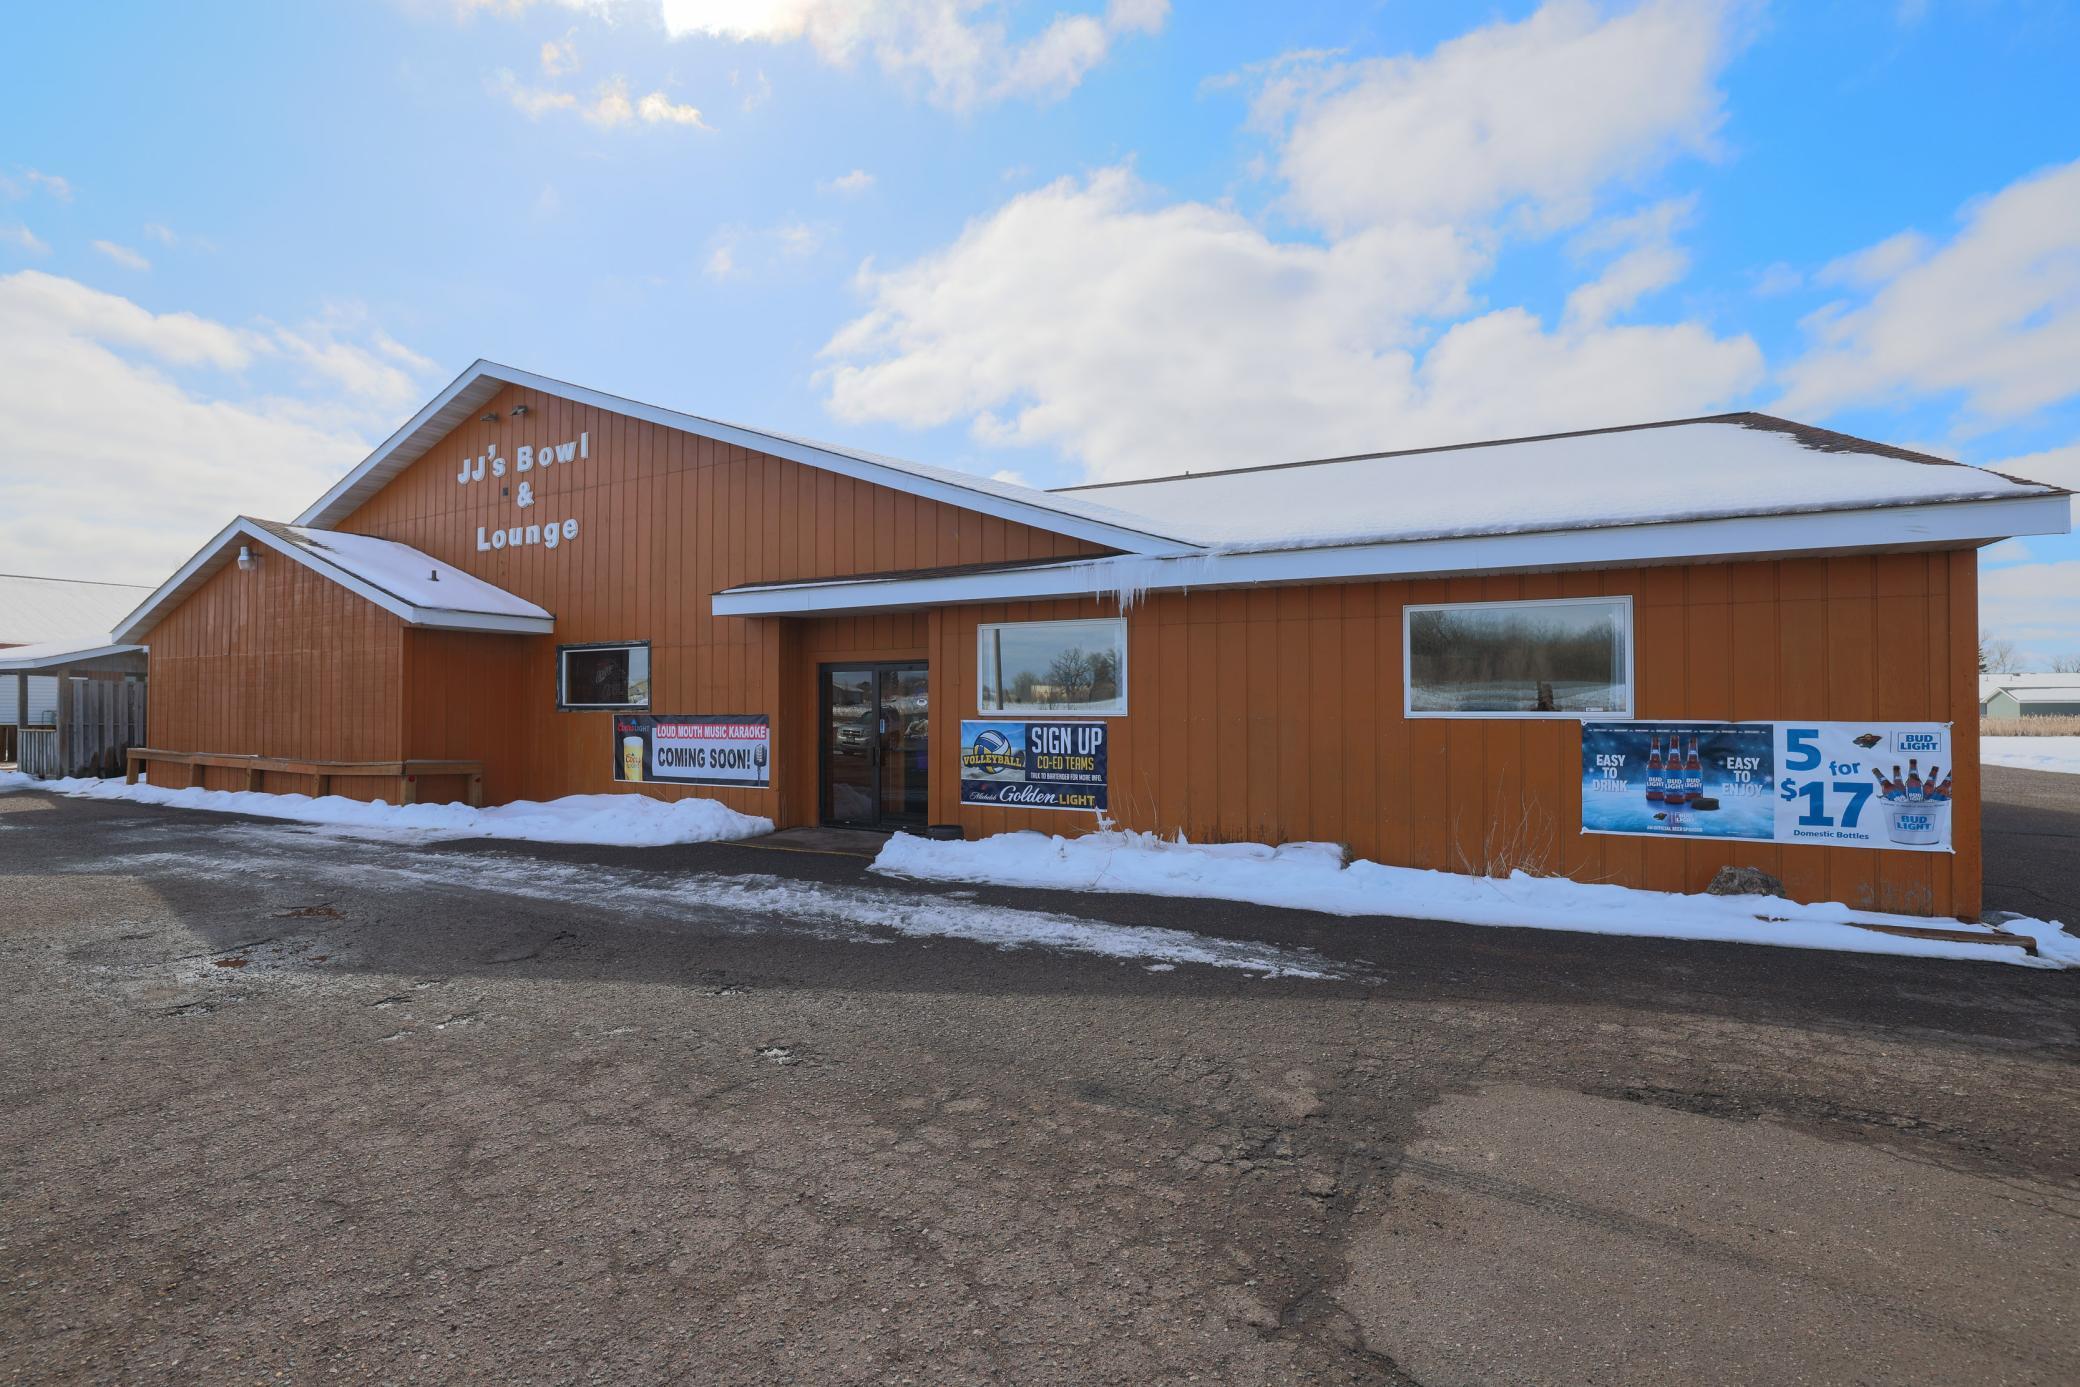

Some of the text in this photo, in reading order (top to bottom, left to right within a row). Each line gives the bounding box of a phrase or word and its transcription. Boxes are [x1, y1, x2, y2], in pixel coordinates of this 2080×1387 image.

[457, 431, 589, 485] JJ's Bowl
[516, 481, 535, 508] &
[476, 518, 579, 552] Lounge
[657, 725, 766, 739] LOUD MOUTH MUSIC KARAOKE
[1905, 734, 1934, 743] BUD
[1031, 727, 1103, 755] SIGN UP
[1900, 742, 1939, 751] LIGHT
[658, 747, 706, 769] COMING
[710, 748, 751, 770] SOON!
[1785, 728, 1861, 776] 5 for
[963, 754, 1022, 767] VOLLEYBALL
[1037, 755, 1094, 771] CO-ED TEAMS
[1596, 754, 1626, 767] EASY
[1726, 757, 1760, 770] EASY
[1601, 767, 1618, 779] TO
[1733, 770, 1751, 783] TO
[1592, 779, 1628, 793] DRINK
[1722, 783, 1763, 798] ENJOY
[999, 784, 1058, 804] Golden
[1059, 794, 1095, 807] LIGHT
[1780, 777, 1874, 828] $17
[1896, 822, 1933, 831] LIGHT
[1901, 815, 1928, 824] BUD
[1793, 829, 1870, 840] Domestic Bottles
